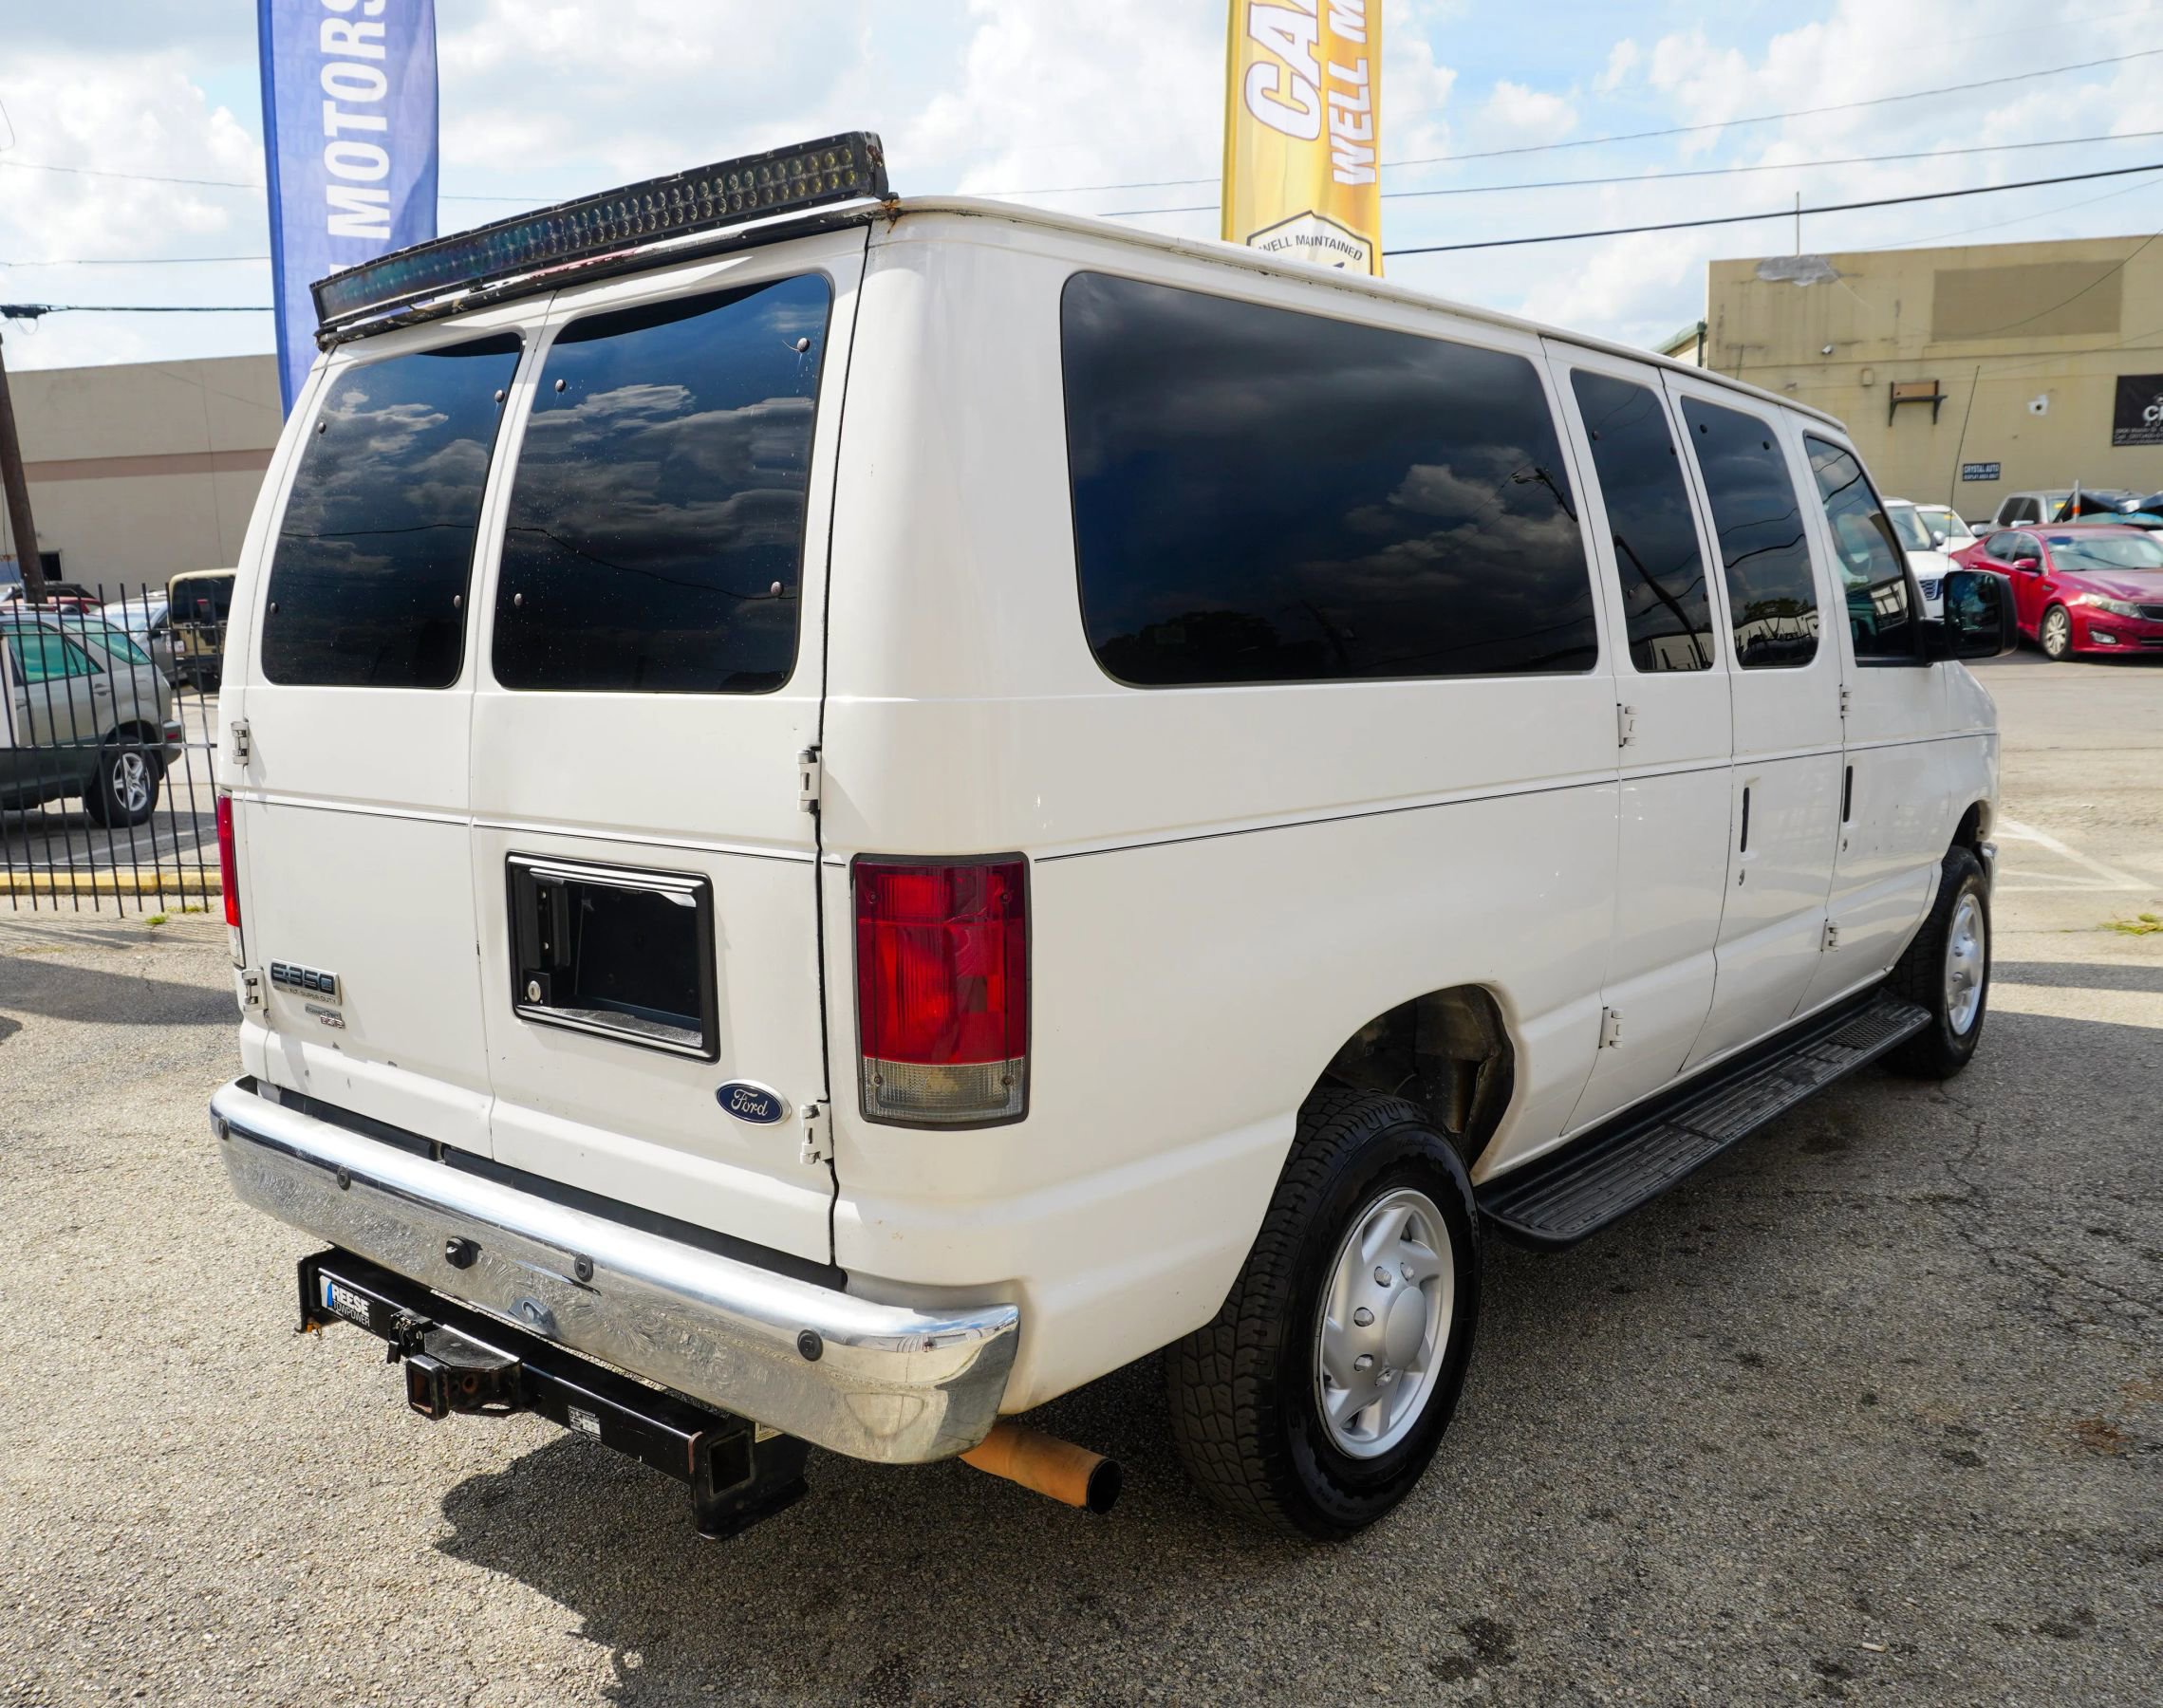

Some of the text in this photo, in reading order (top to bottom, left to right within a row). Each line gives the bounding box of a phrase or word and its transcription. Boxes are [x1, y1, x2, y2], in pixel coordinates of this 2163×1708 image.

[1244, 0, 1322, 140] CA
[1328, 58, 1377, 186] WELL
[1296, 234, 1363, 262] MAINTAINED
[1964, 463, 2000, 473] CRYSTAL AUTO
[731, 1088, 769, 1116] Ford
[331, 1283, 370, 1317] REESE
[333, 1300, 371, 1327] TOWPOWER
